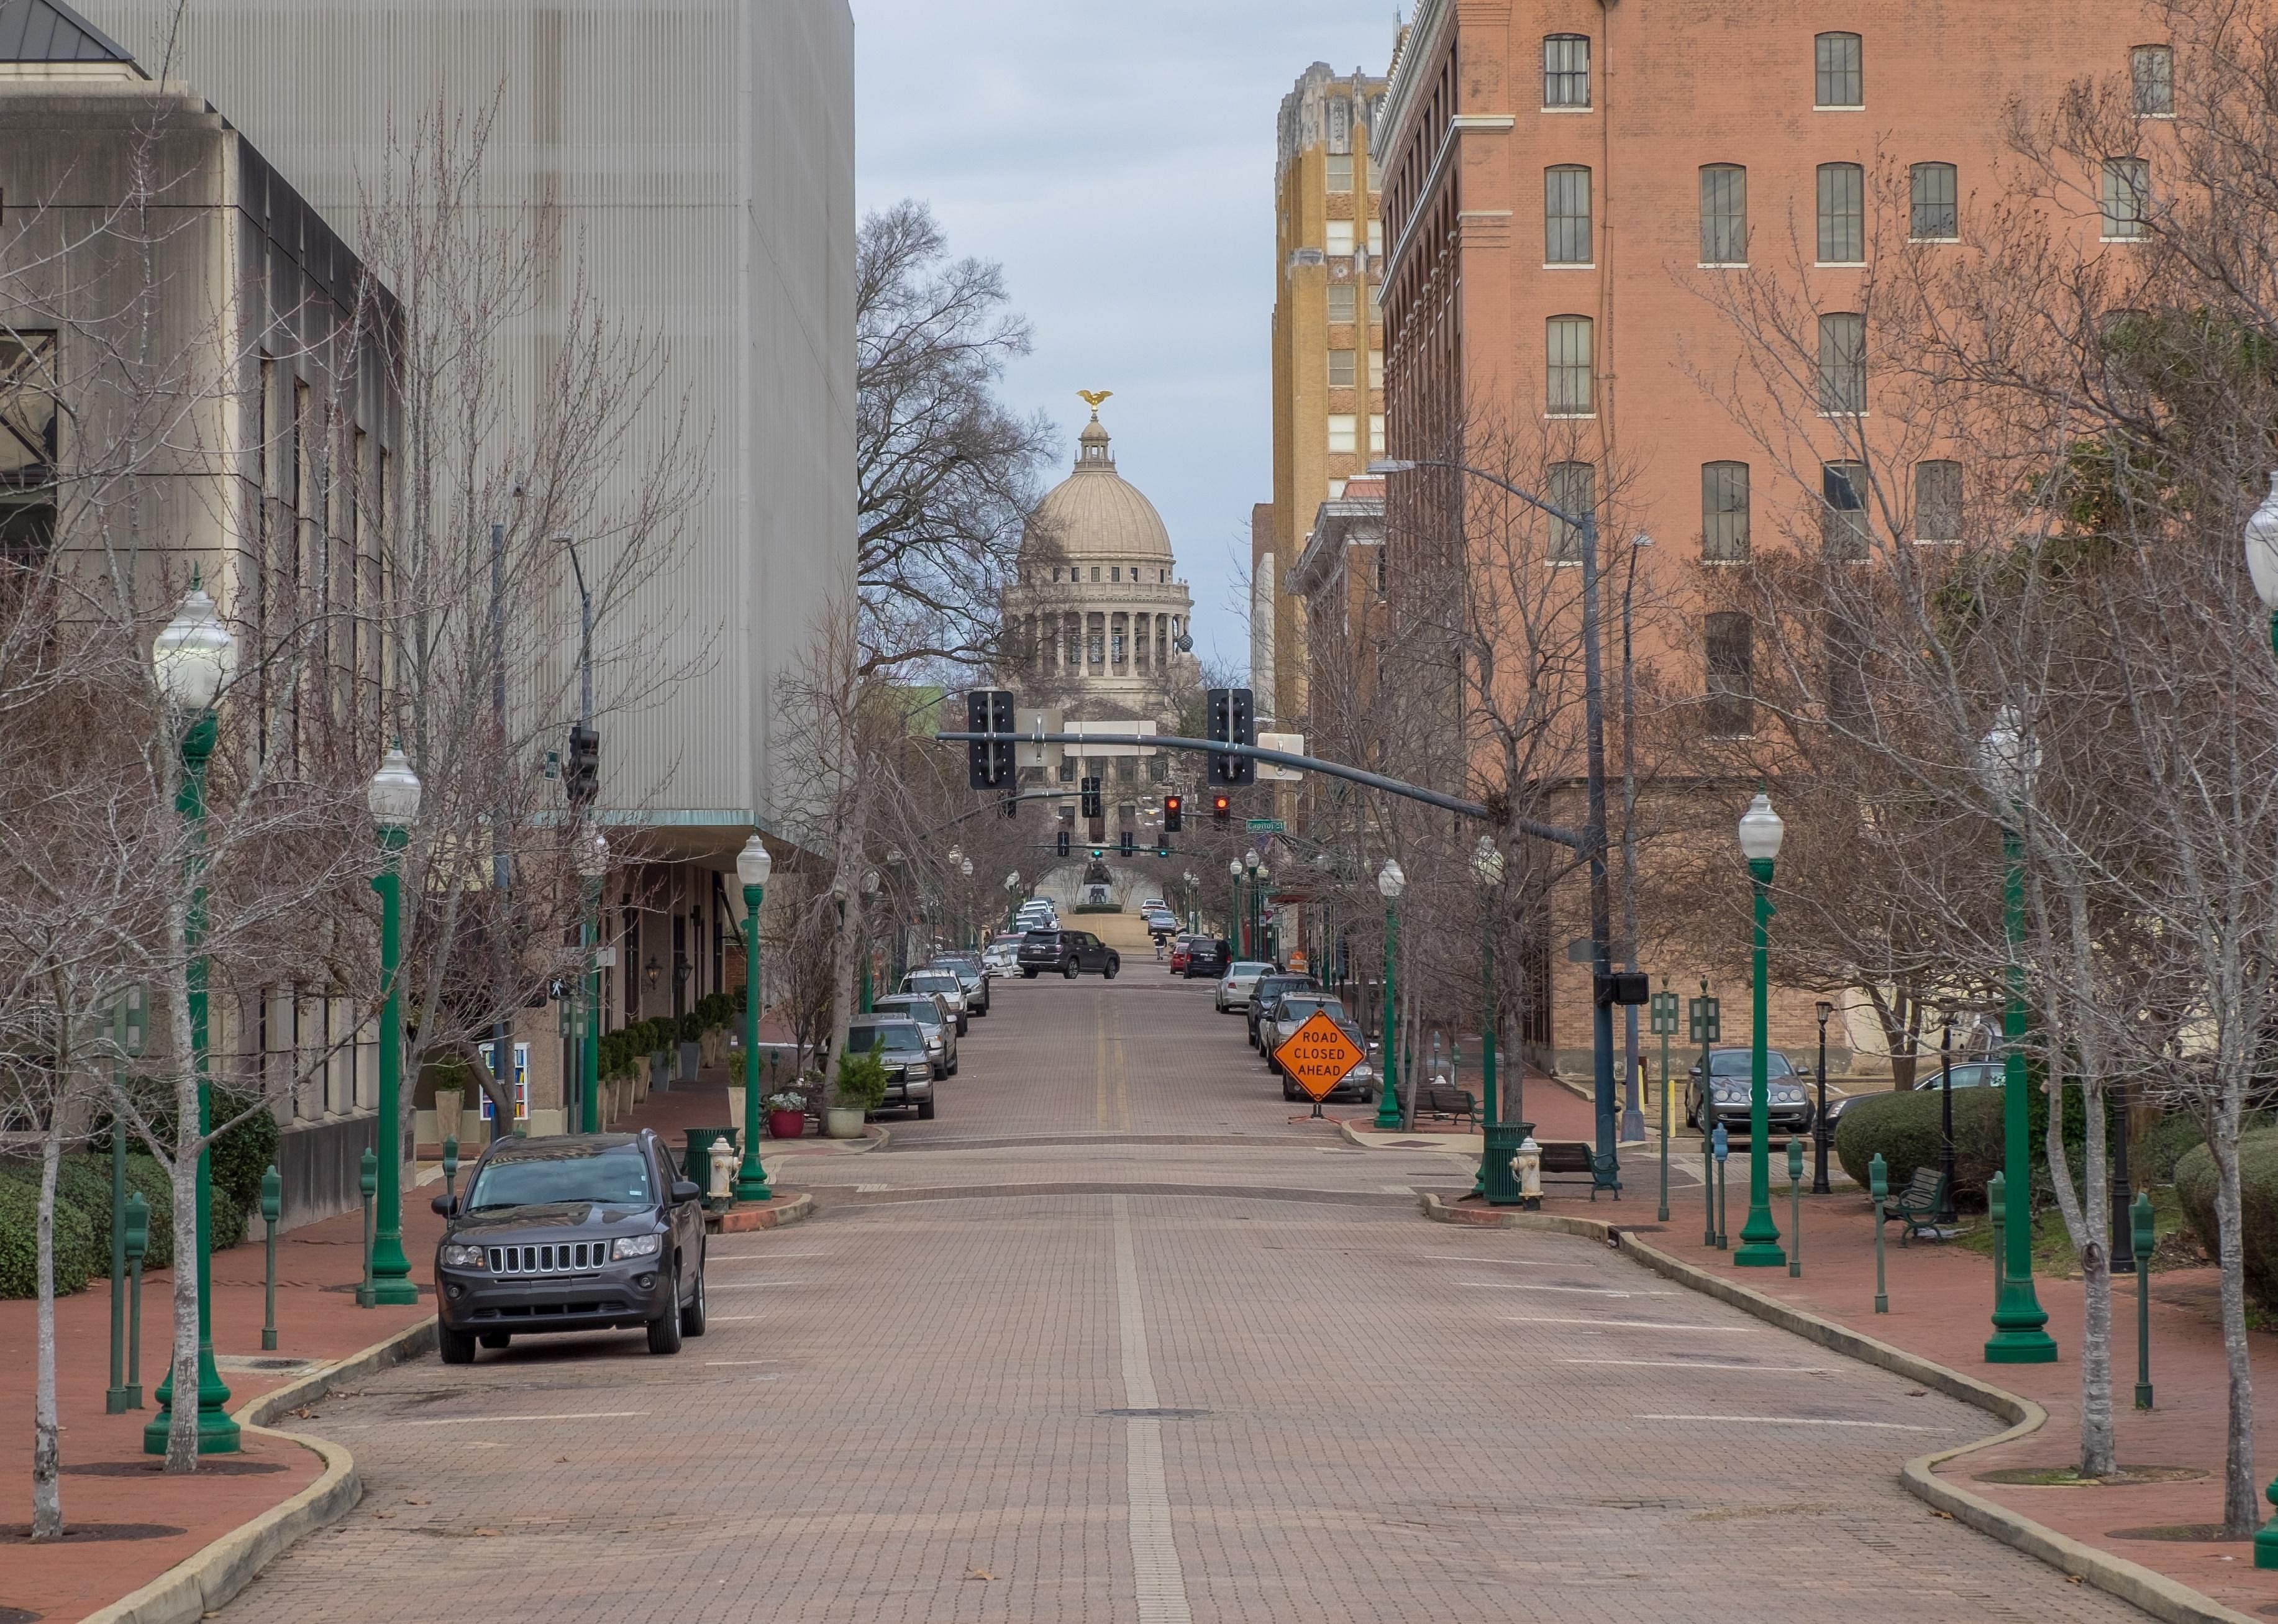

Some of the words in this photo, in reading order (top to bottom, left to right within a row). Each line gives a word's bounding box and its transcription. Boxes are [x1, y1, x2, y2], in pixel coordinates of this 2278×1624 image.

[1303, 1032, 1337, 1042] ROAD
[1294, 1048, 1345, 1059] CLOSED
[1298, 1065, 1341, 1076] AHEAD
